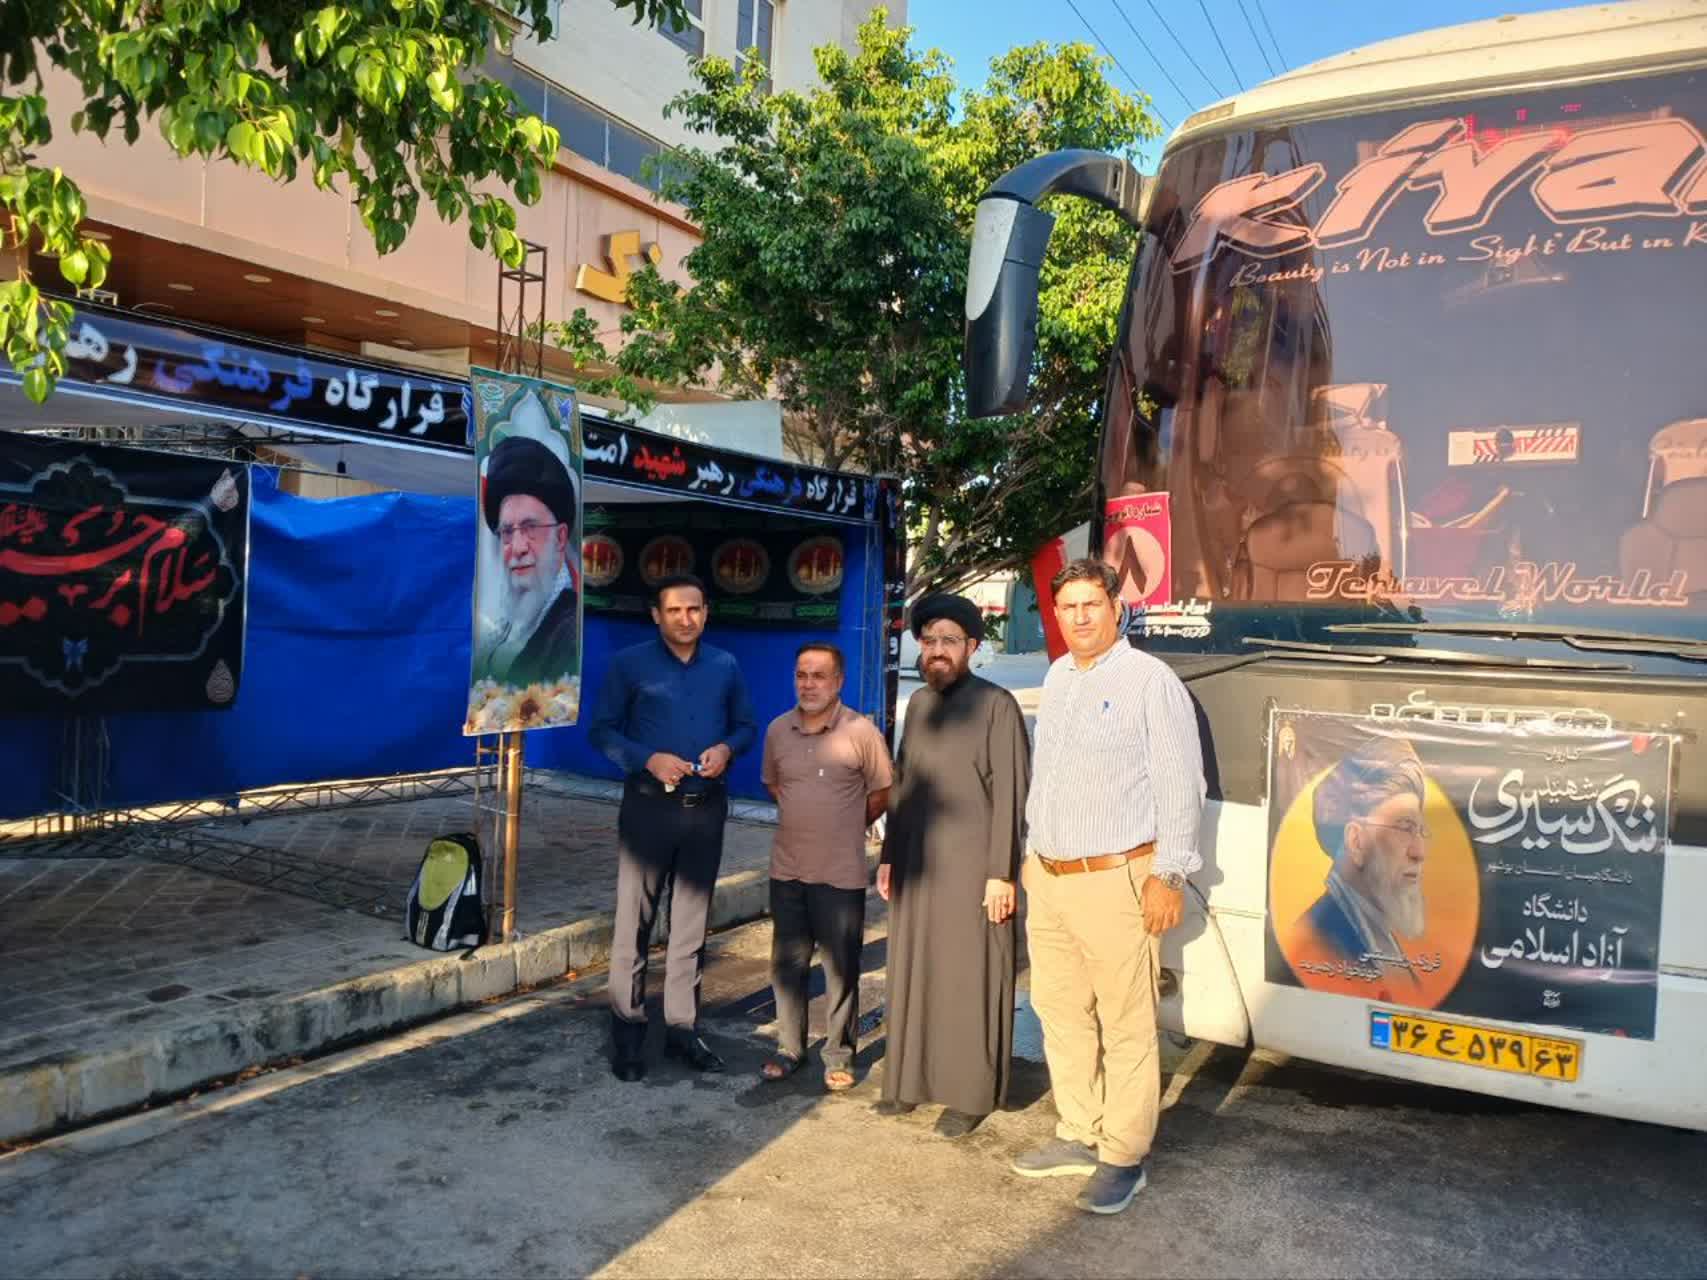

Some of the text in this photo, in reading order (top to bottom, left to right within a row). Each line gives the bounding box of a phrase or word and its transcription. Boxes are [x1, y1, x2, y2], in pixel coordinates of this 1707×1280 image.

[1229, 262, 1324, 288] Beauty
[1331, 261, 1350, 274] is
[1356, 247, 1411, 273] Not
[1418, 252, 1446, 265] in
[1566, 226, 1633, 253] But
[1642, 237, 1673, 249] in
[632, 445, 687, 481] شهید
[687, 460, 736, 496] رهبر
[138, 528, 217, 638] سلام
[1514, 561, 1689, 608] World
[1522, 893, 1589, 923] دانشگاه
[1480, 925, 1629, 981] آزاد اسلامی
[1436, 1028, 1459, 1056] ع
[1467, 1033, 1526, 1068] ۵۳۹
[1535, 1050, 1573, 1077] ۶۳
